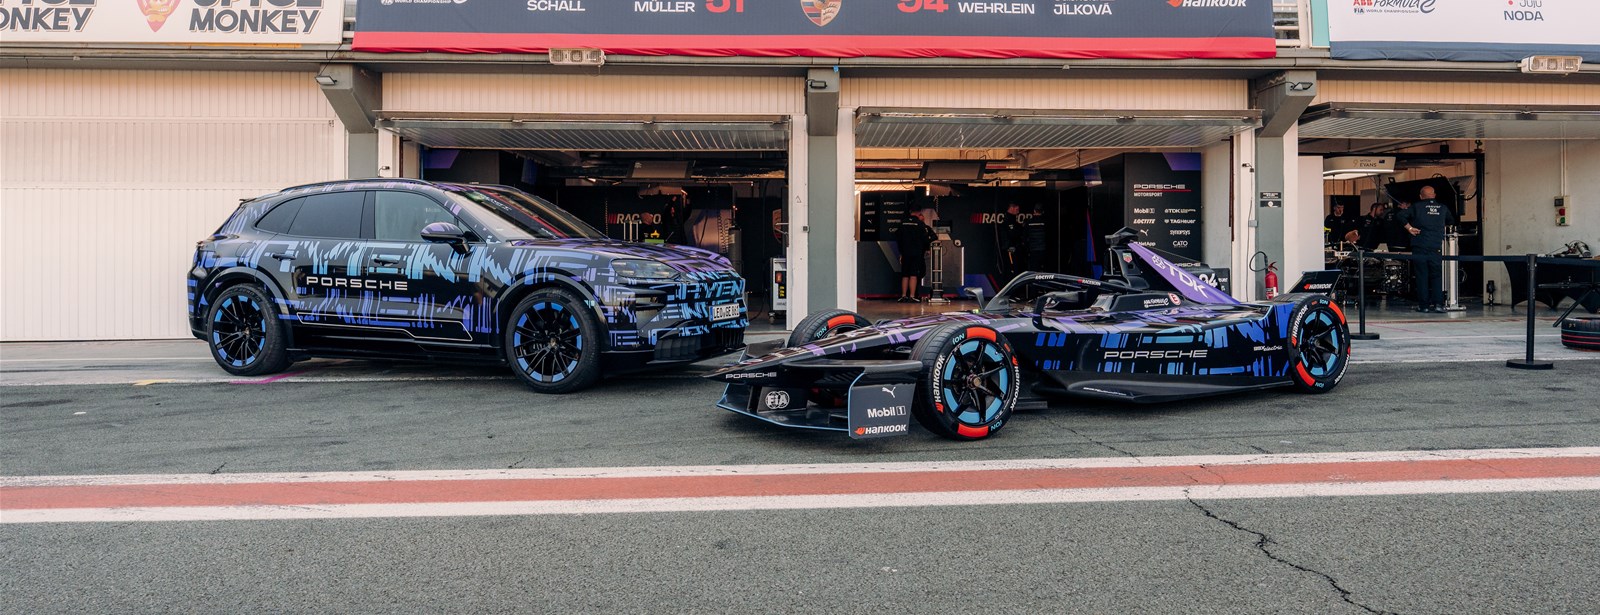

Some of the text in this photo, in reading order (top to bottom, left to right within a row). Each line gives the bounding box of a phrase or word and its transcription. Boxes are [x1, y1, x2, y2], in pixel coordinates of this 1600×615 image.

[527, 0, 586, 12] SCHALL
[634, 0, 696, 13] MÜLLER
[958, 2, 1036, 15] WEHRLEIN
[1053, 3, 1113, 15] JÍLKOVÁ
[189, 8, 321, 34] MONKEY
[1503, 10, 1544, 21] NODA
[306, 276, 408, 291] PORSCHE
[1164, 260, 1209, 298] TDK
[1103, 349, 1209, 360] PORSCHE
[725, 371, 777, 379] PORSCHE
[766, 394, 787, 406] FIA
[867, 405, 907, 418] Mobil 1
